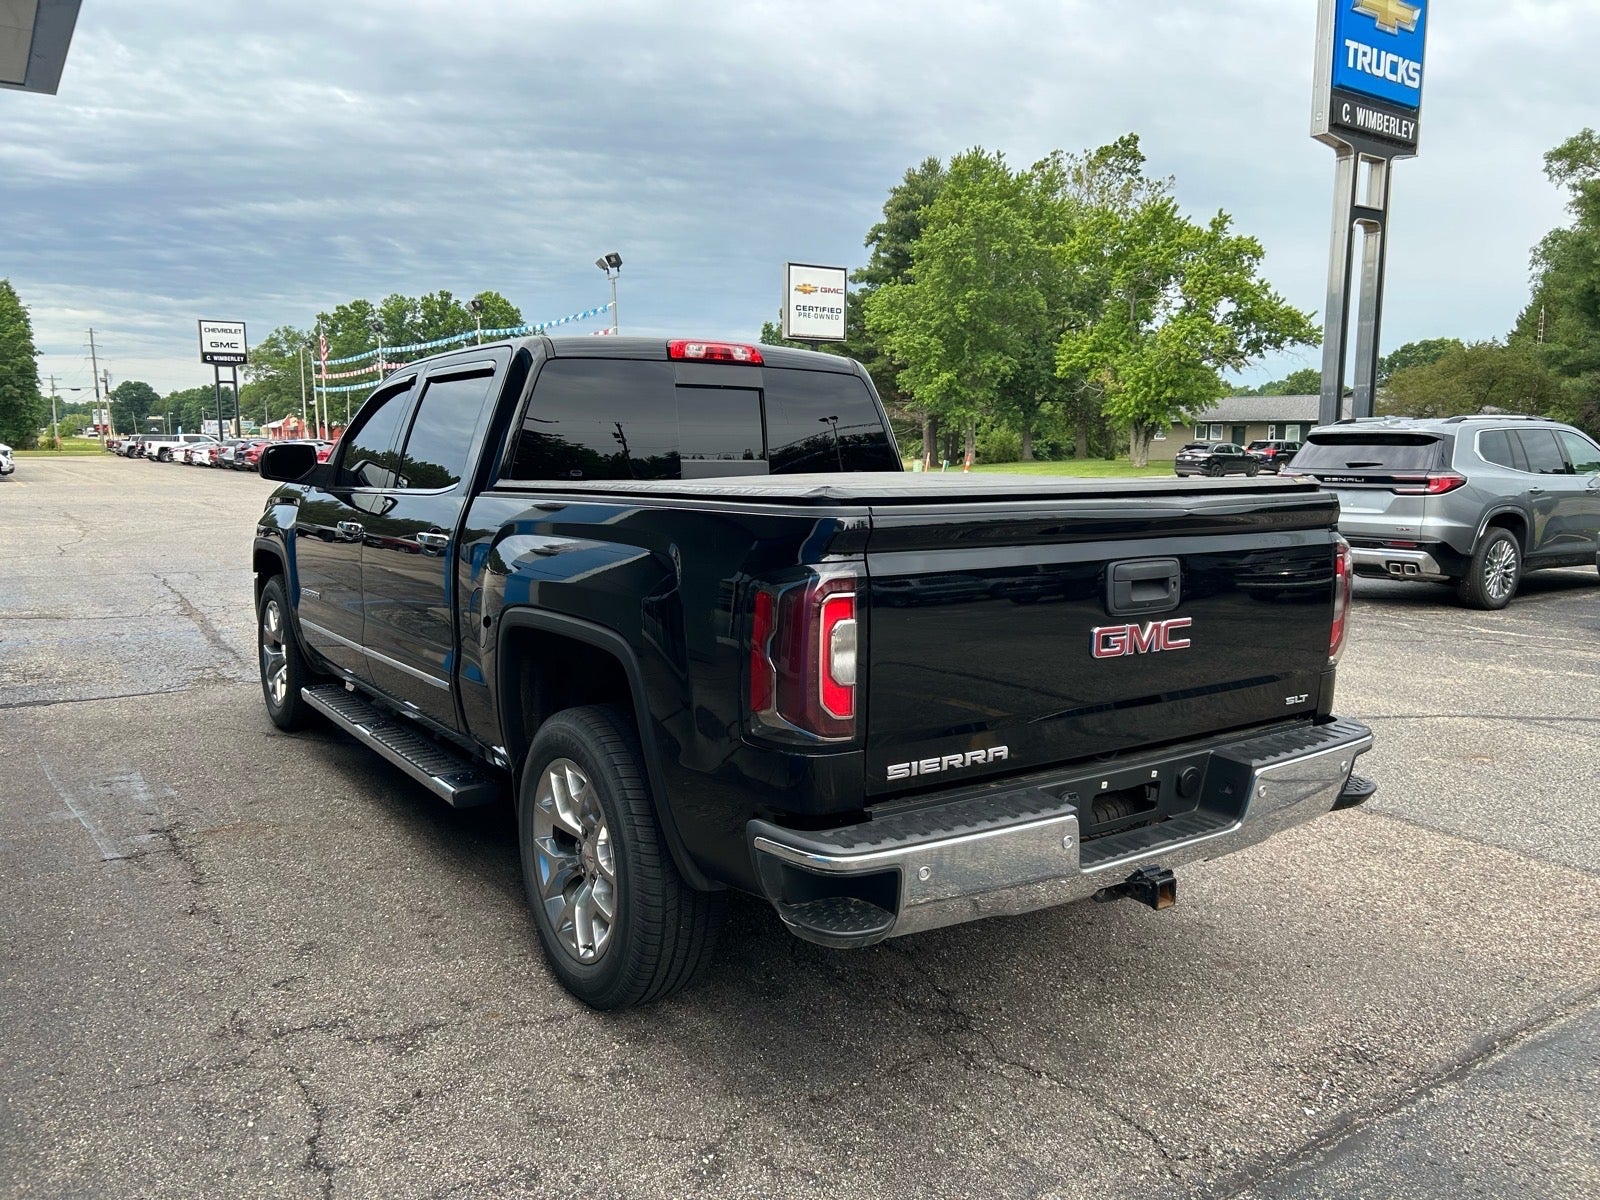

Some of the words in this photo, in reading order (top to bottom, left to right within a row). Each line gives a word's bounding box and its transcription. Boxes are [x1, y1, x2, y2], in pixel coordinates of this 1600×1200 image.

[1344, 39, 1421, 89] TRUCKS
[1342, 103, 1351, 124] C.
[1356, 106, 1415, 140] WIMBERLEY
[820, 286, 844, 295] GMC
[795, 304, 842, 314] CERTIFIED
[797, 312, 840, 321] PRE-OWNED
[203, 327, 242, 335] CHEVROLET
[210, 341, 239, 349] GMC
[1090, 617, 1193, 659] GMC
[1285, 693, 1309, 705] SLT
[886, 745, 1009, 781] SIERRA
